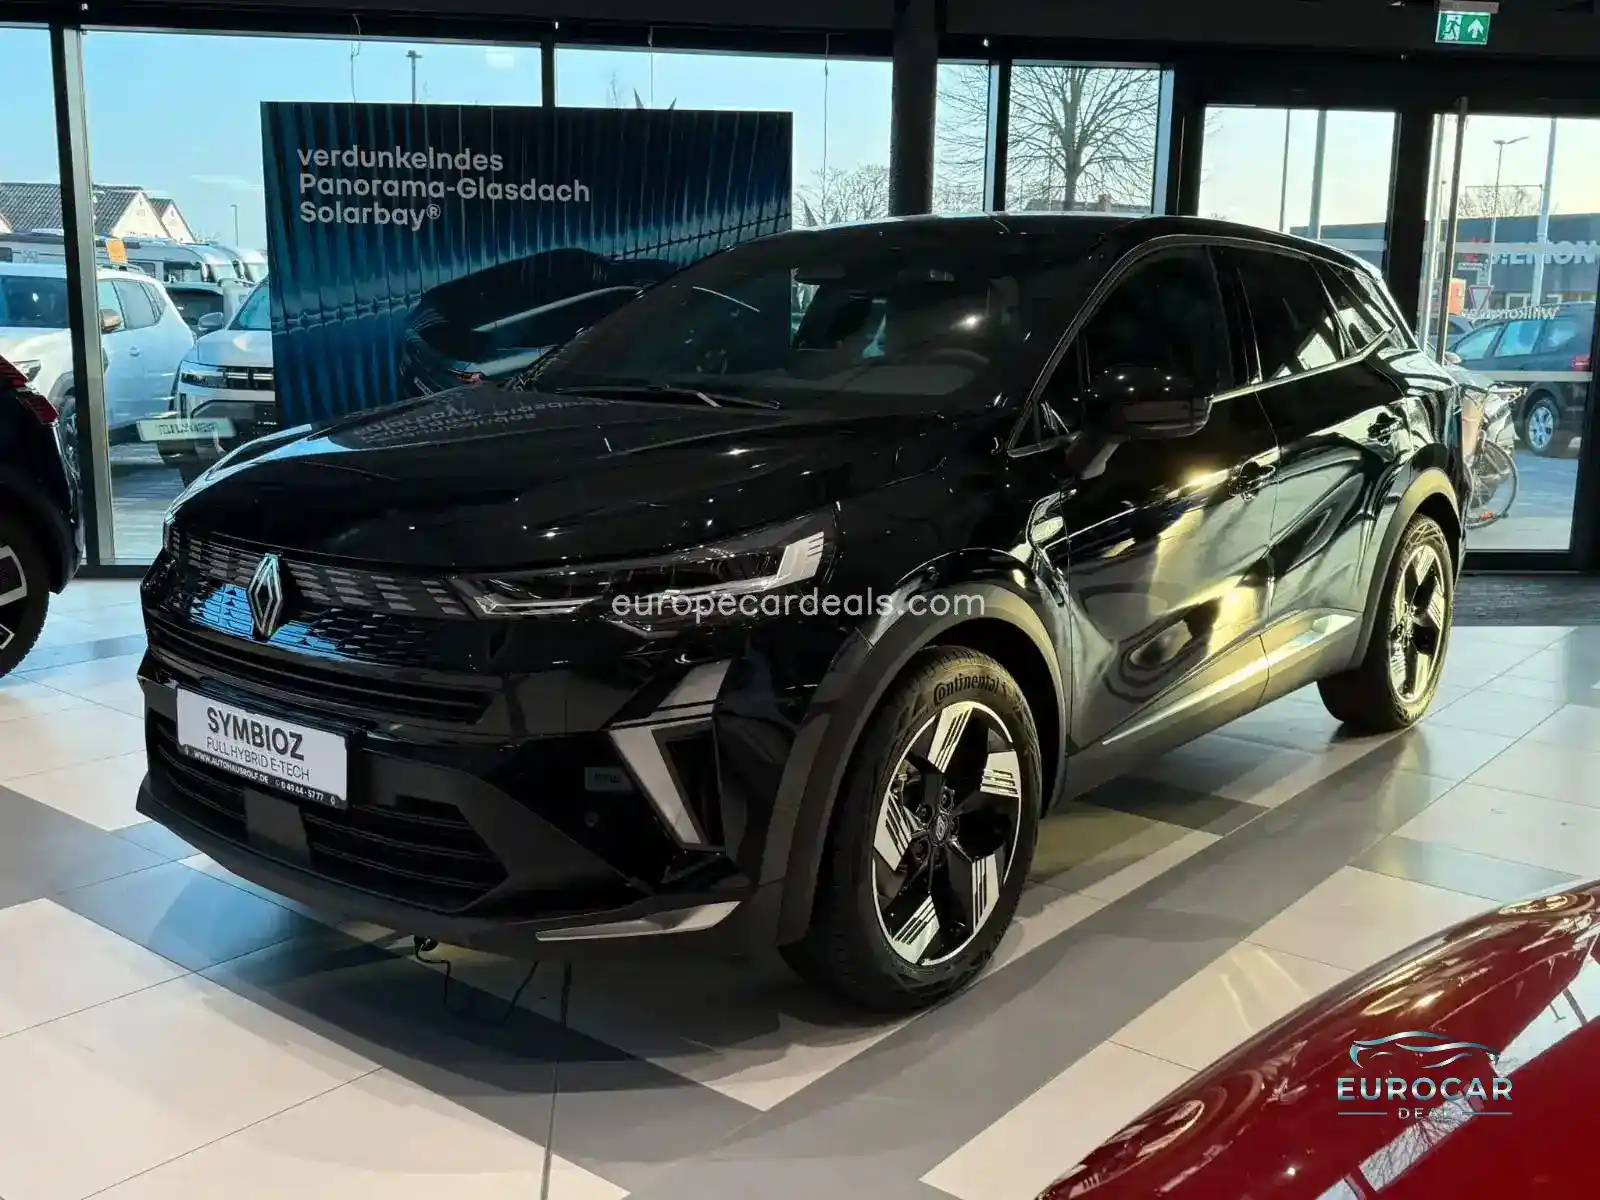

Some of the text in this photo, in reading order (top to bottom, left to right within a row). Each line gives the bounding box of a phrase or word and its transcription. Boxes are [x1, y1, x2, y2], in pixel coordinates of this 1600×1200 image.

[297, 145, 504, 172] verdunkelndes
[299, 173, 591, 202] Panorama-Glasdach
[933, 673, 1000, 707] Continental
[206, 706, 305, 762] SYMBIOZ
[206, 736, 310, 781] FULL HYBRID E-TECH
